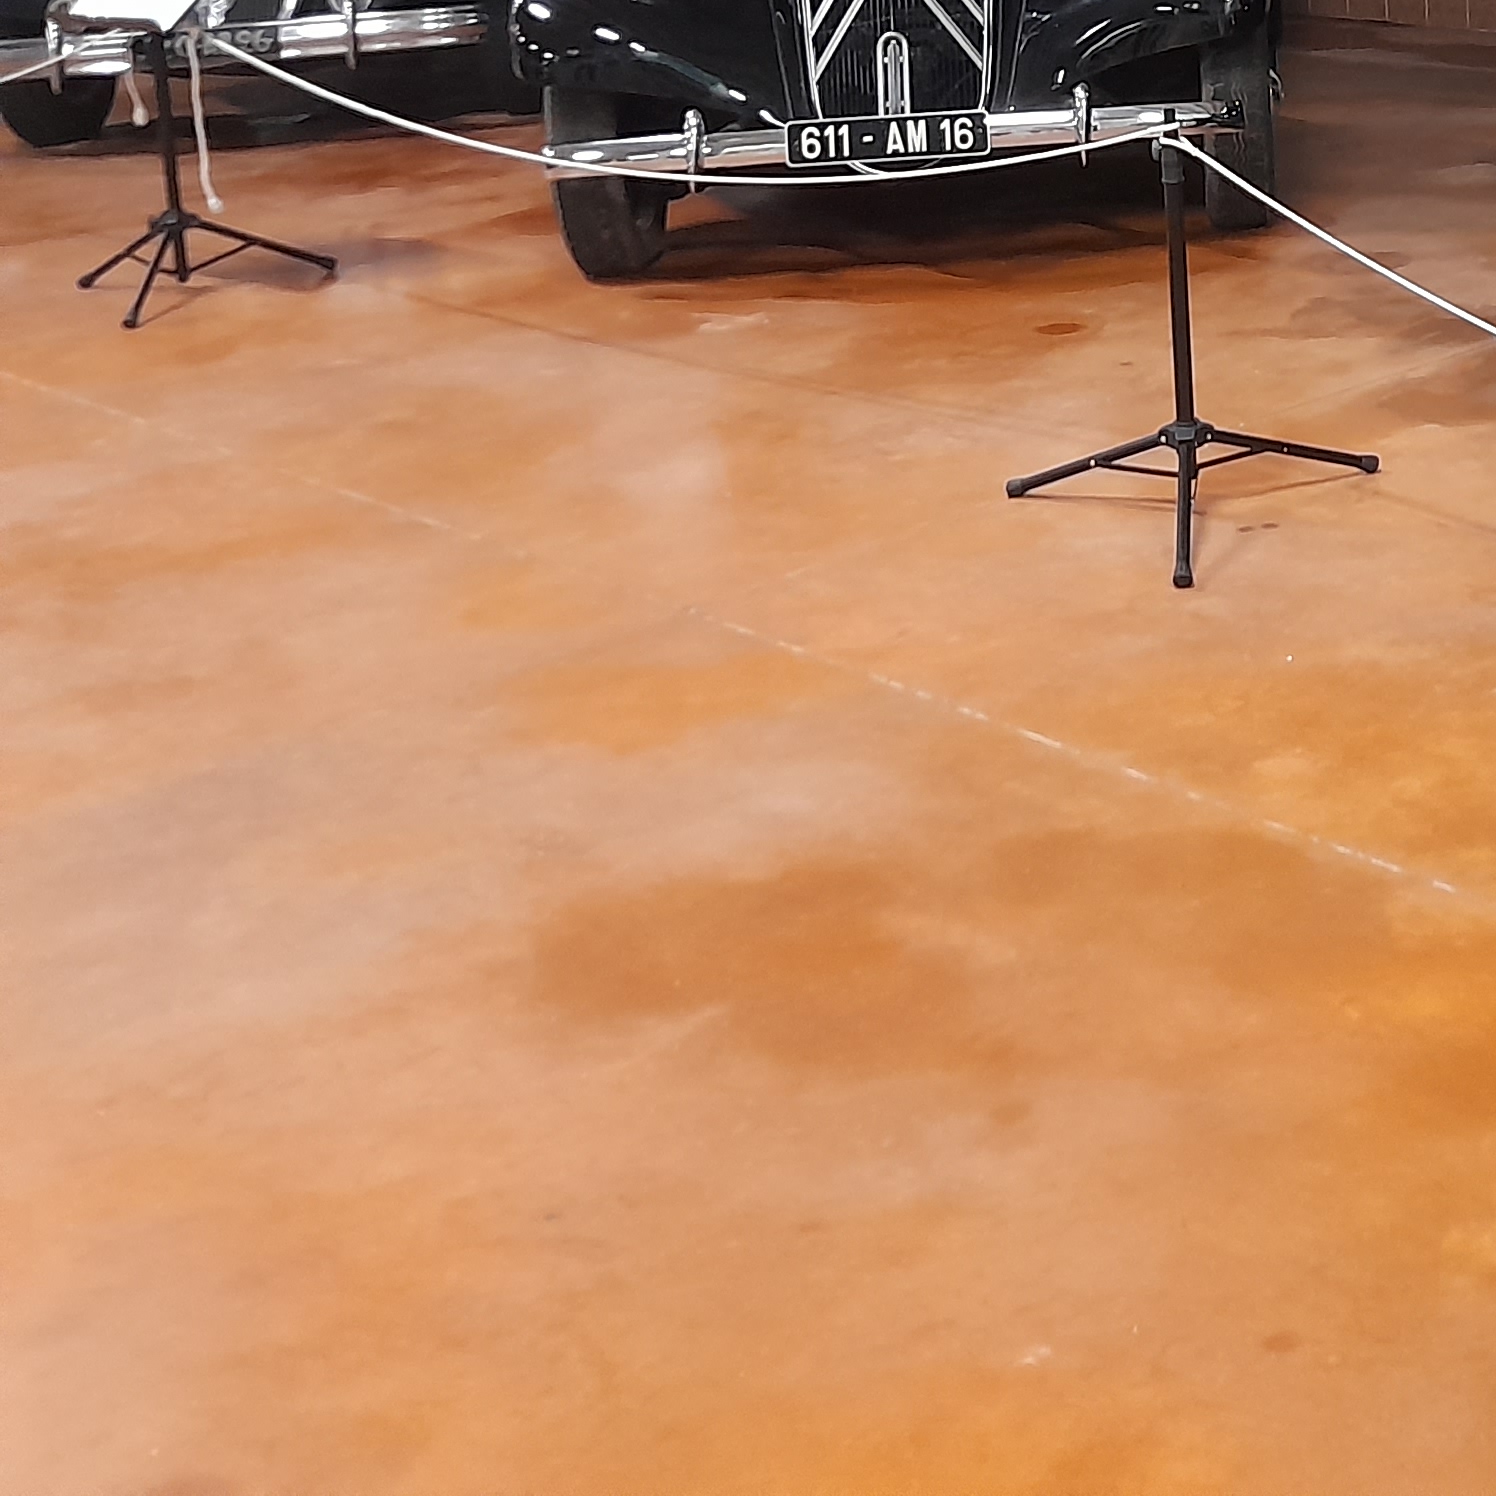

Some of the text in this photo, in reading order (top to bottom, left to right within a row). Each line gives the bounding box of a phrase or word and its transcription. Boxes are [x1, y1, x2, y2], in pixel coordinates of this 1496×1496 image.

[801, 124, 850, 159] 611
[886, 119, 927, 155] AM
[939, 117, 975, 151] 16
